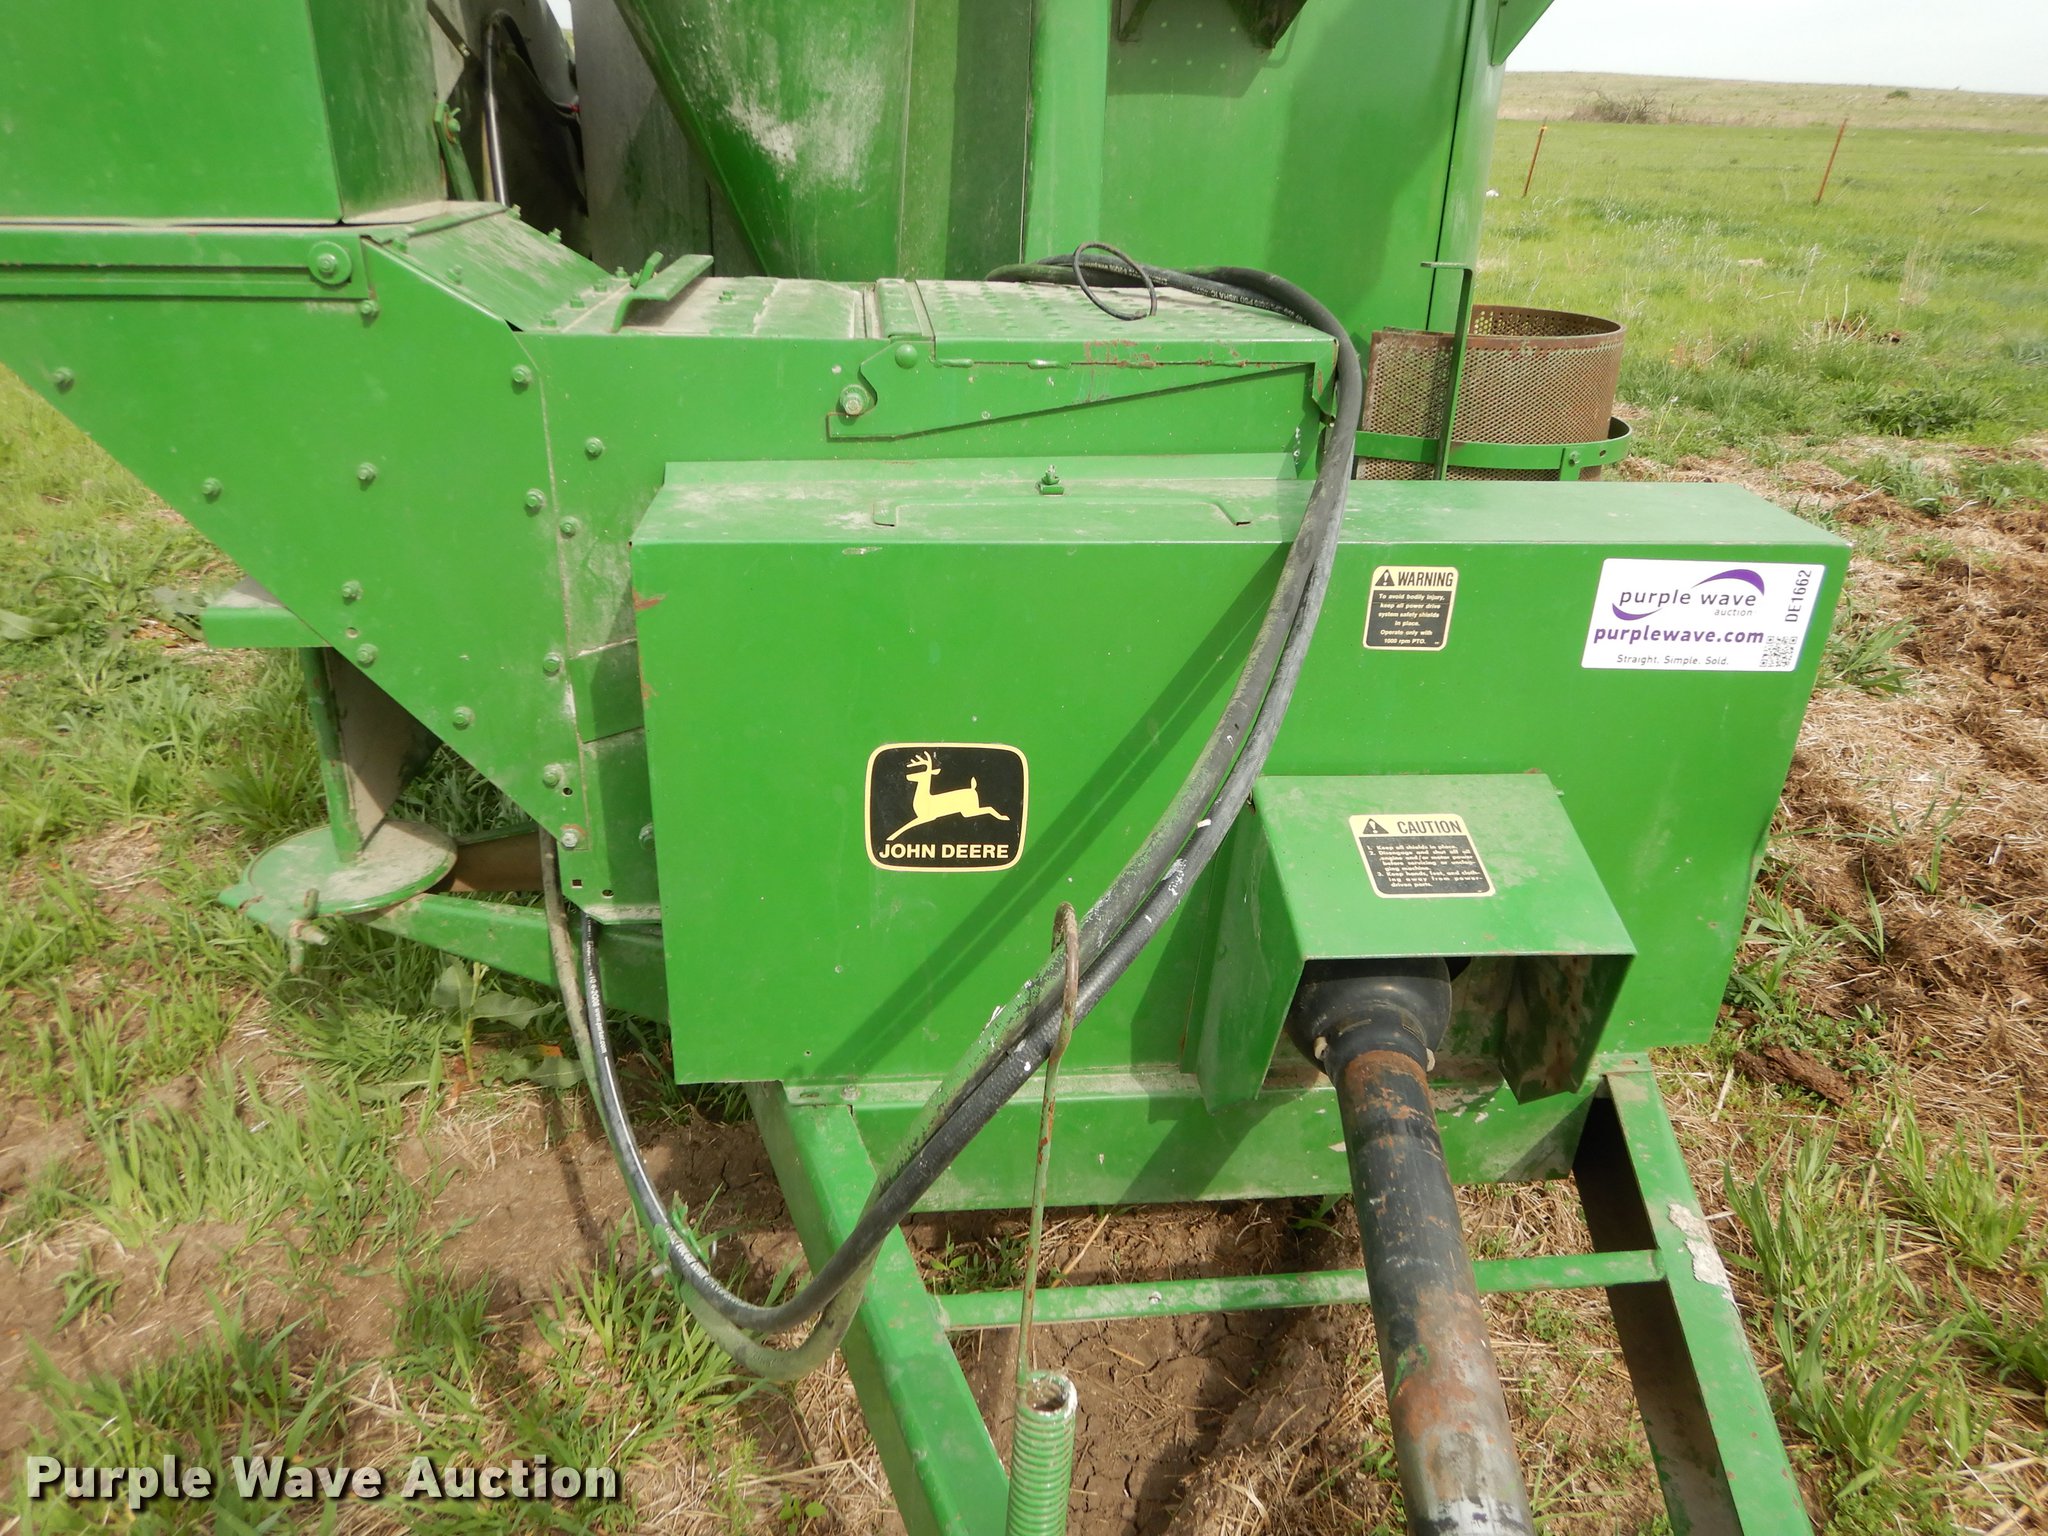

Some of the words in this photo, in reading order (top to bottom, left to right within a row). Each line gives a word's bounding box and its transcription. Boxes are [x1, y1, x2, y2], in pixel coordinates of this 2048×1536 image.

[1398, 572, 1453, 586] WARNING
[1620, 590, 1691, 607] purple
[1701, 593, 1757, 606] wave
[1785, 569, 1812, 623] DE1662
[1594, 625, 1764, 644] purplewave.com
[1616, 654, 1659, 664] Straight.
[1664, 656, 1700, 665] Simple.
[1705, 656, 1729, 665] Sold.
[1397, 821, 1462, 833] CAUTION
[879, 844, 935, 858] JOHN
[942, 844, 1008, 859] DEERE
